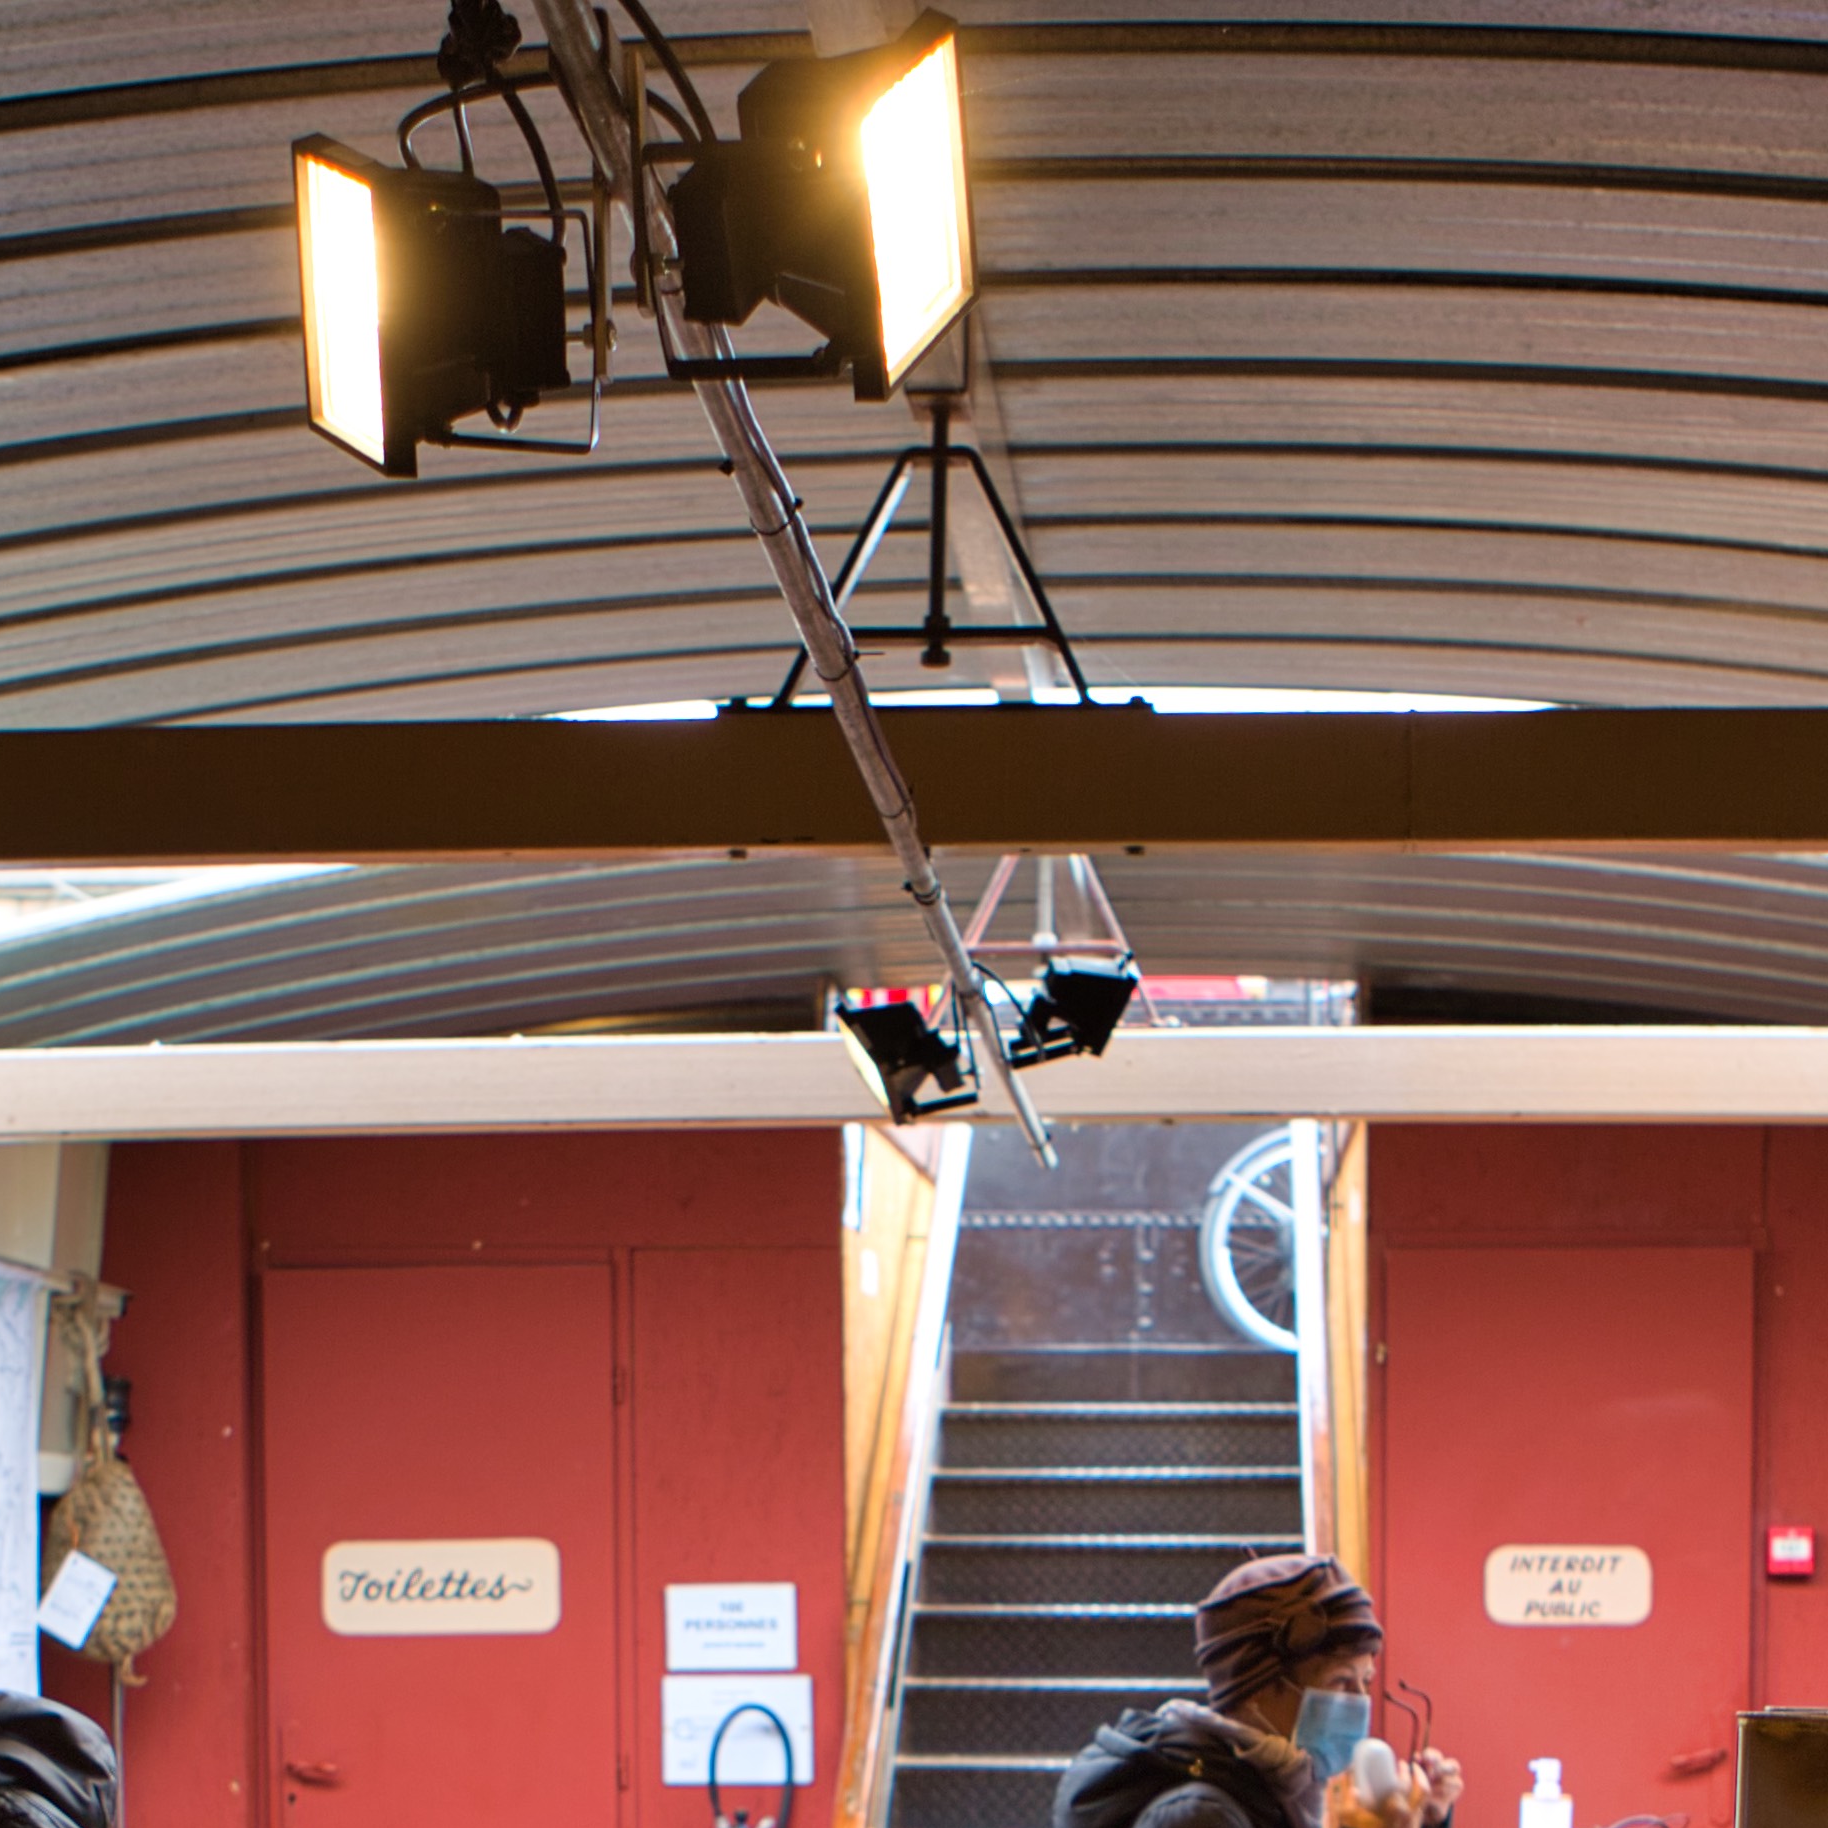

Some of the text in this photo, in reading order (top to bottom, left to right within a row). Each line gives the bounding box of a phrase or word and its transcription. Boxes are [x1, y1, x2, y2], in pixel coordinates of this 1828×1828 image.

[1509, 1553, 1623, 1574] INTERDIT
[338, 1566, 533, 1603] Toilettes
[1548, 1577, 1583, 1596] AU
[1524, 1598, 1603, 1619] PUBLIC
